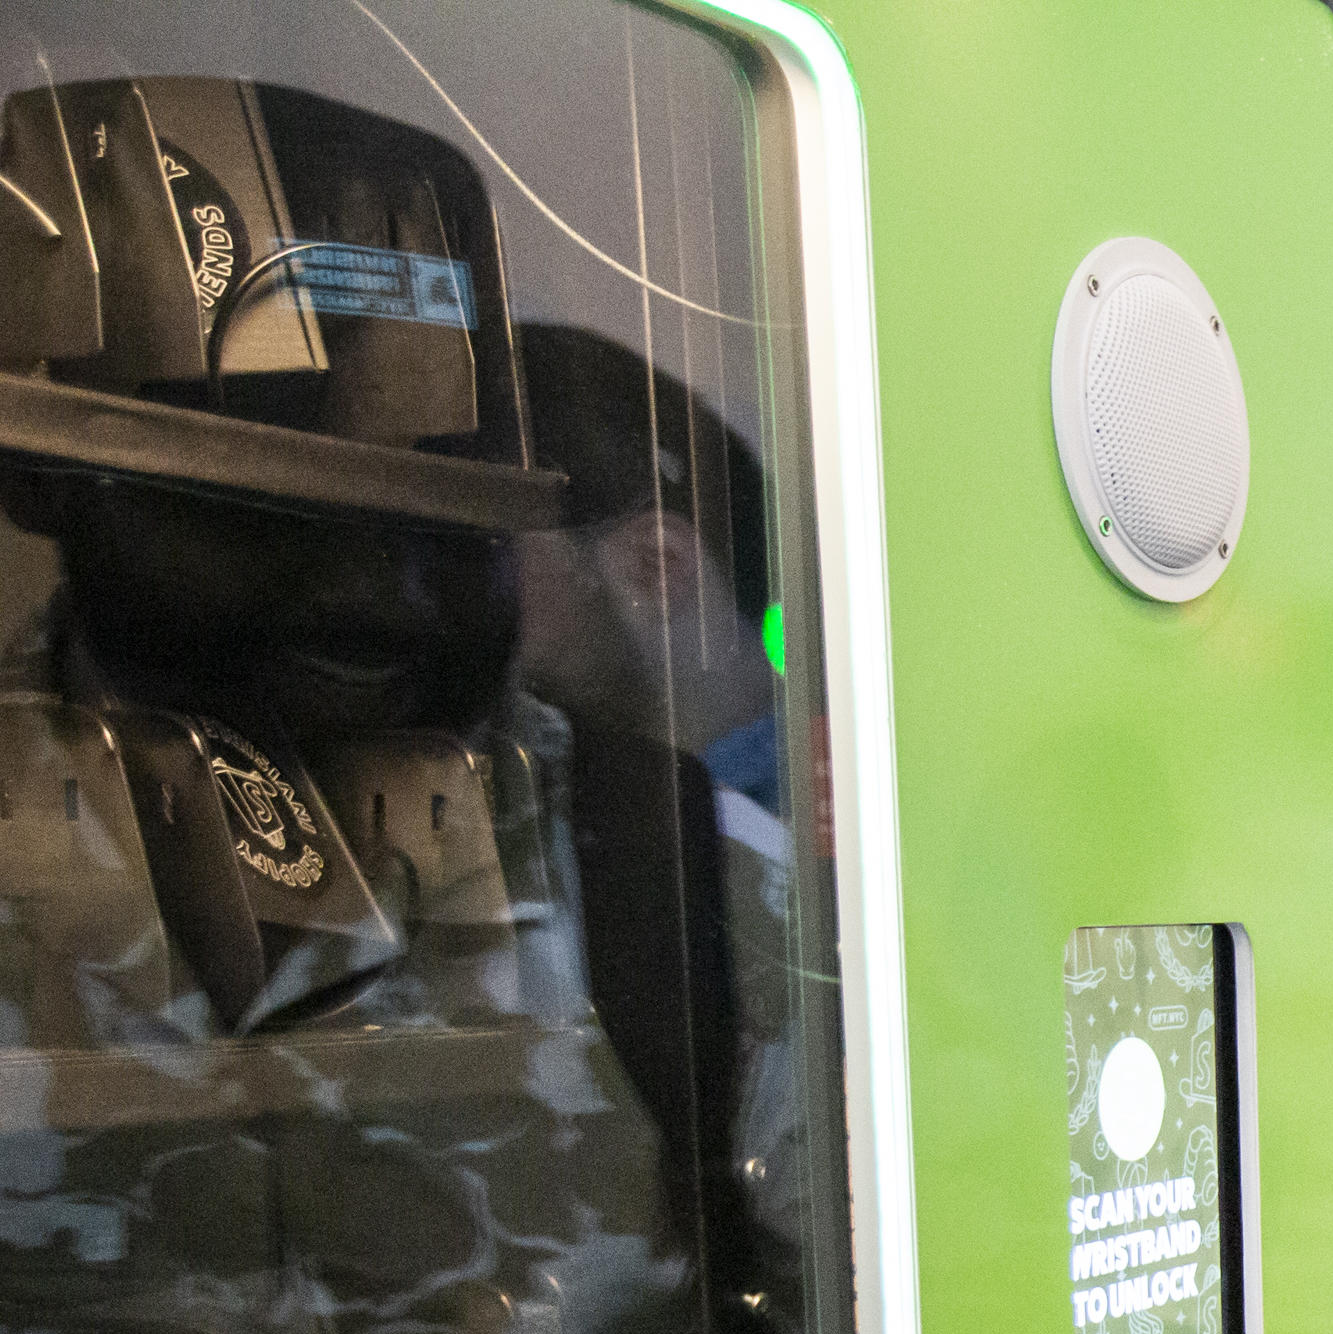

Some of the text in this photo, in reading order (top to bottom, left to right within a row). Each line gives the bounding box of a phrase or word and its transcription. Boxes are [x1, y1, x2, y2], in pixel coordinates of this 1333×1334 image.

[236, 839, 324, 888] SHOPIFY
[1070, 1177, 1196, 1234] SCAN YOUR
[1072, 1219, 1201, 1281] WRISTBAND
[1073, 1263, 1199, 1327] TO UNLOCK
